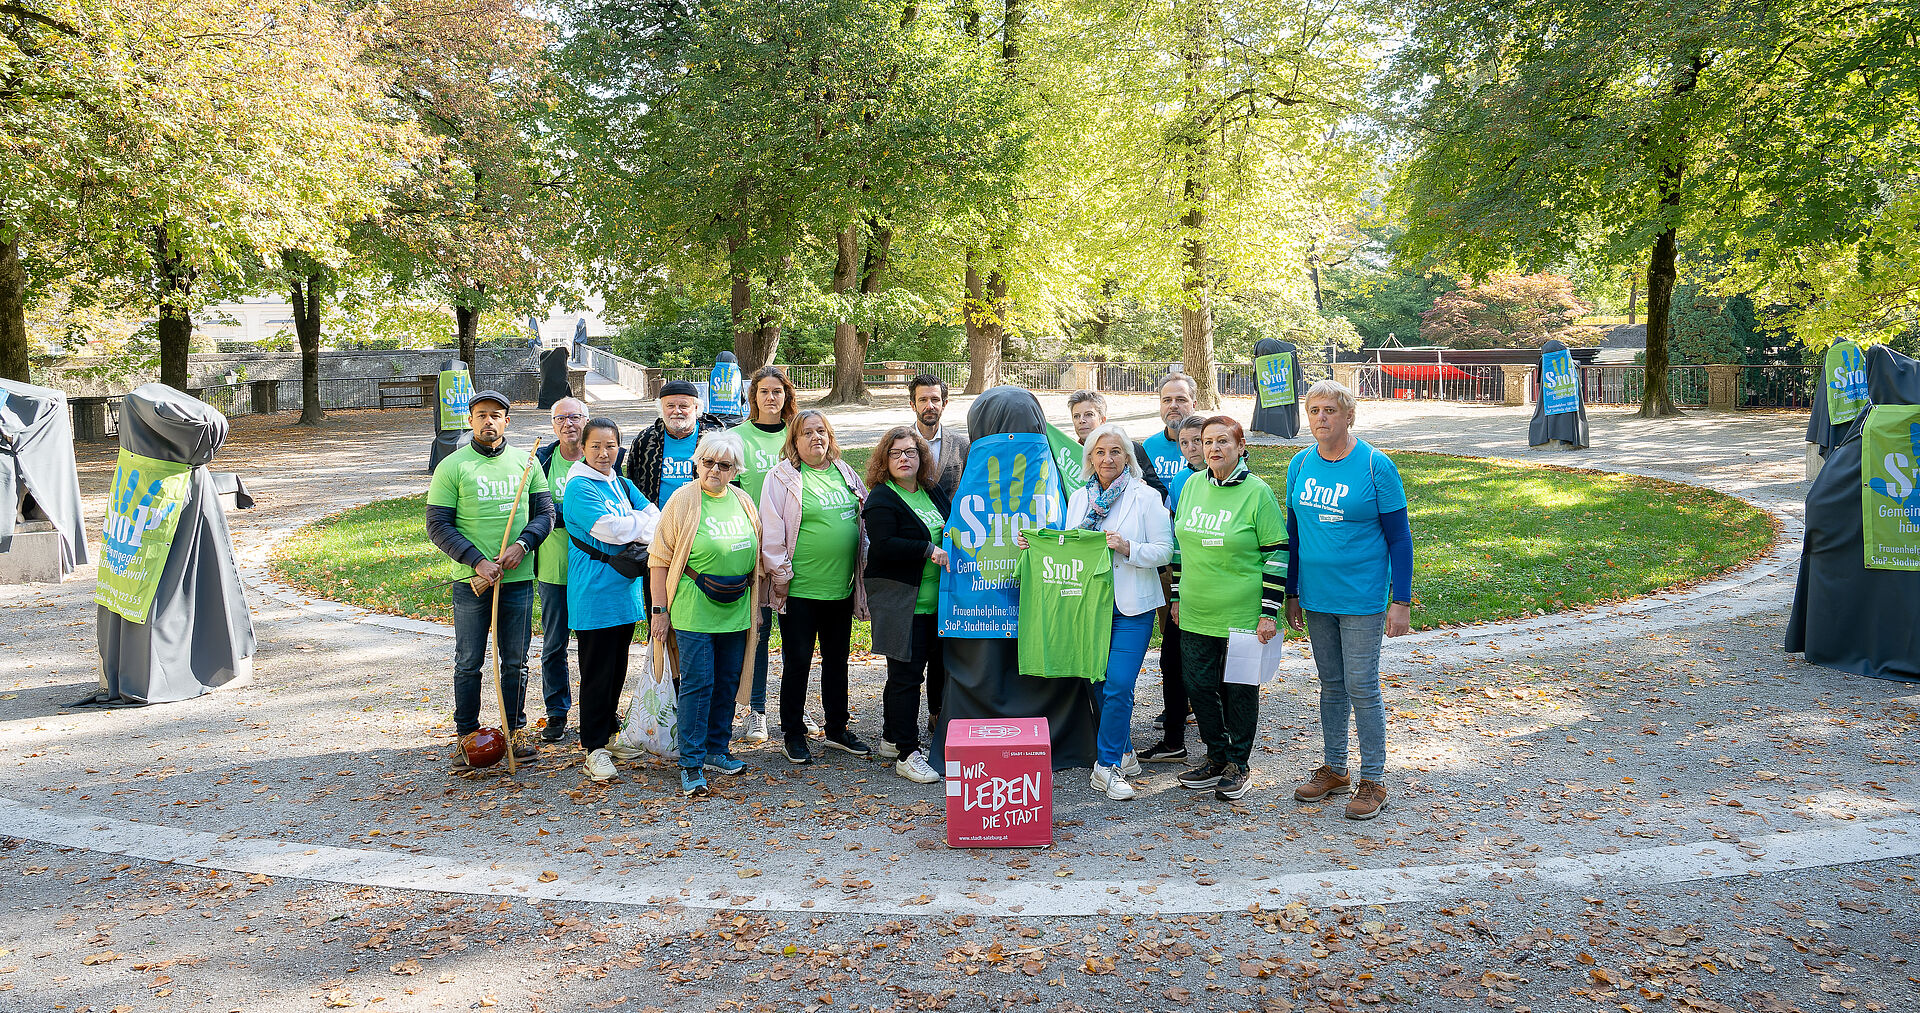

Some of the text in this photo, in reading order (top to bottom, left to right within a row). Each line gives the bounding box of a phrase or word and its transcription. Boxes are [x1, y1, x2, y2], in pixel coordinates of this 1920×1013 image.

[957, 557, 1017, 574] Gemeinsam
[971, 573, 1020, 591] häusliche
[945, 619, 1000, 631] StoP-Stadtteile
[963, 762, 988, 779] WIR
[964, 772, 1041, 812] LEBEN
[982, 805, 1043, 830] DIE STADT
